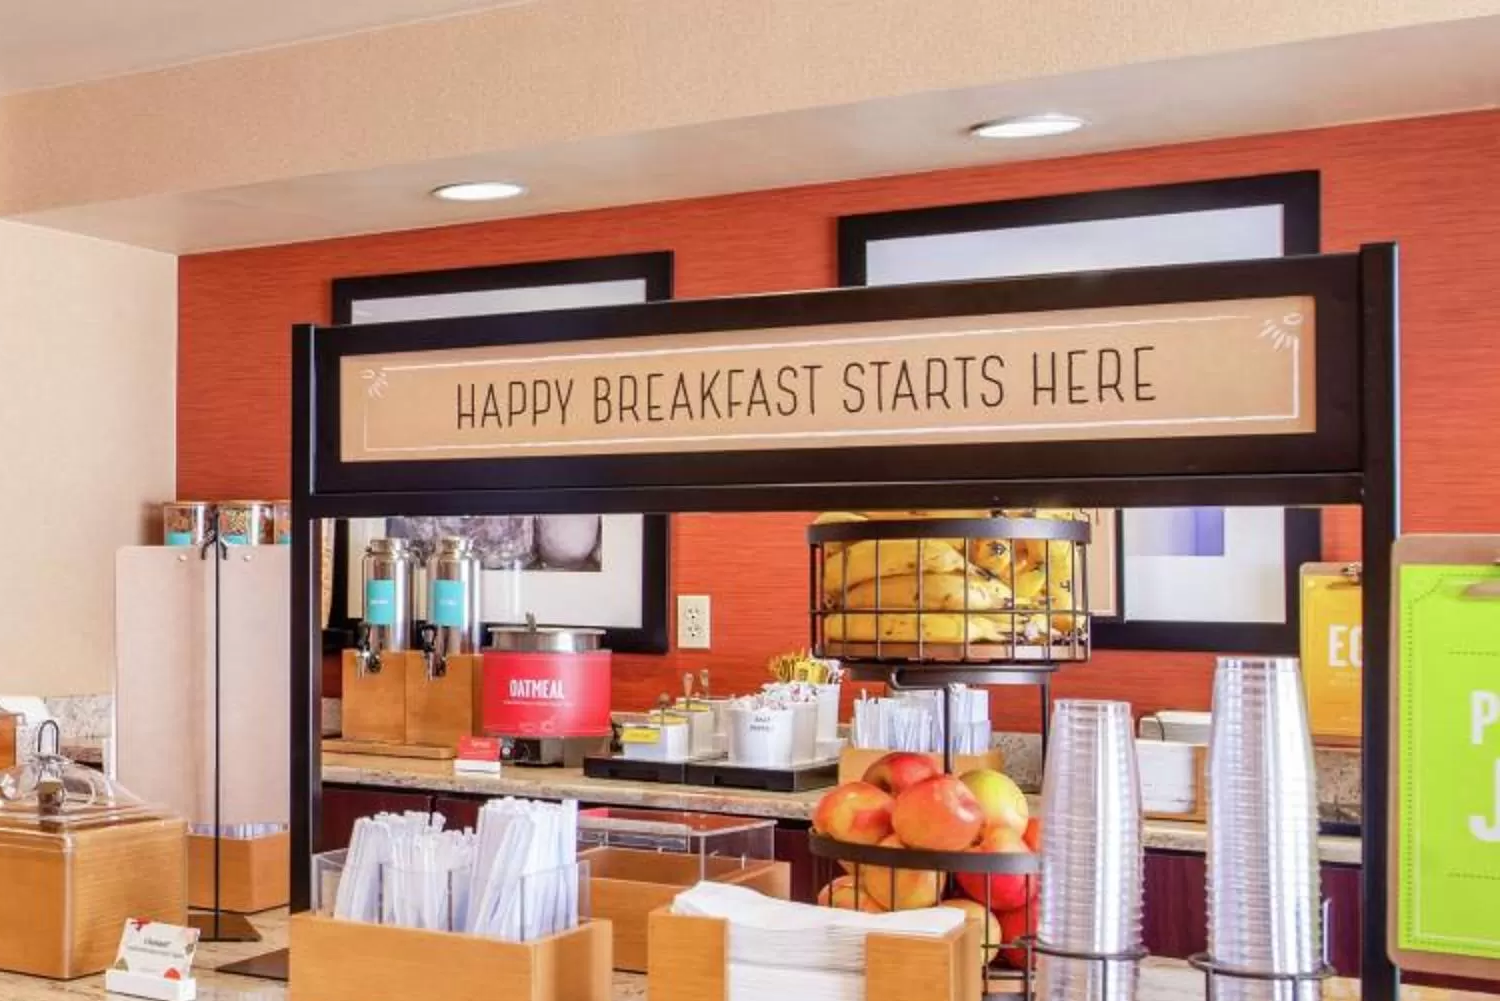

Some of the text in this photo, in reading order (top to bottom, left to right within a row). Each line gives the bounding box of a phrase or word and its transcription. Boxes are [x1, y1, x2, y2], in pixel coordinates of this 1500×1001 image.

[457, 346, 1157, 430] HAPPY BREAKFAST STARTS HERE
[509, 678, 565, 699] OATMEAL
